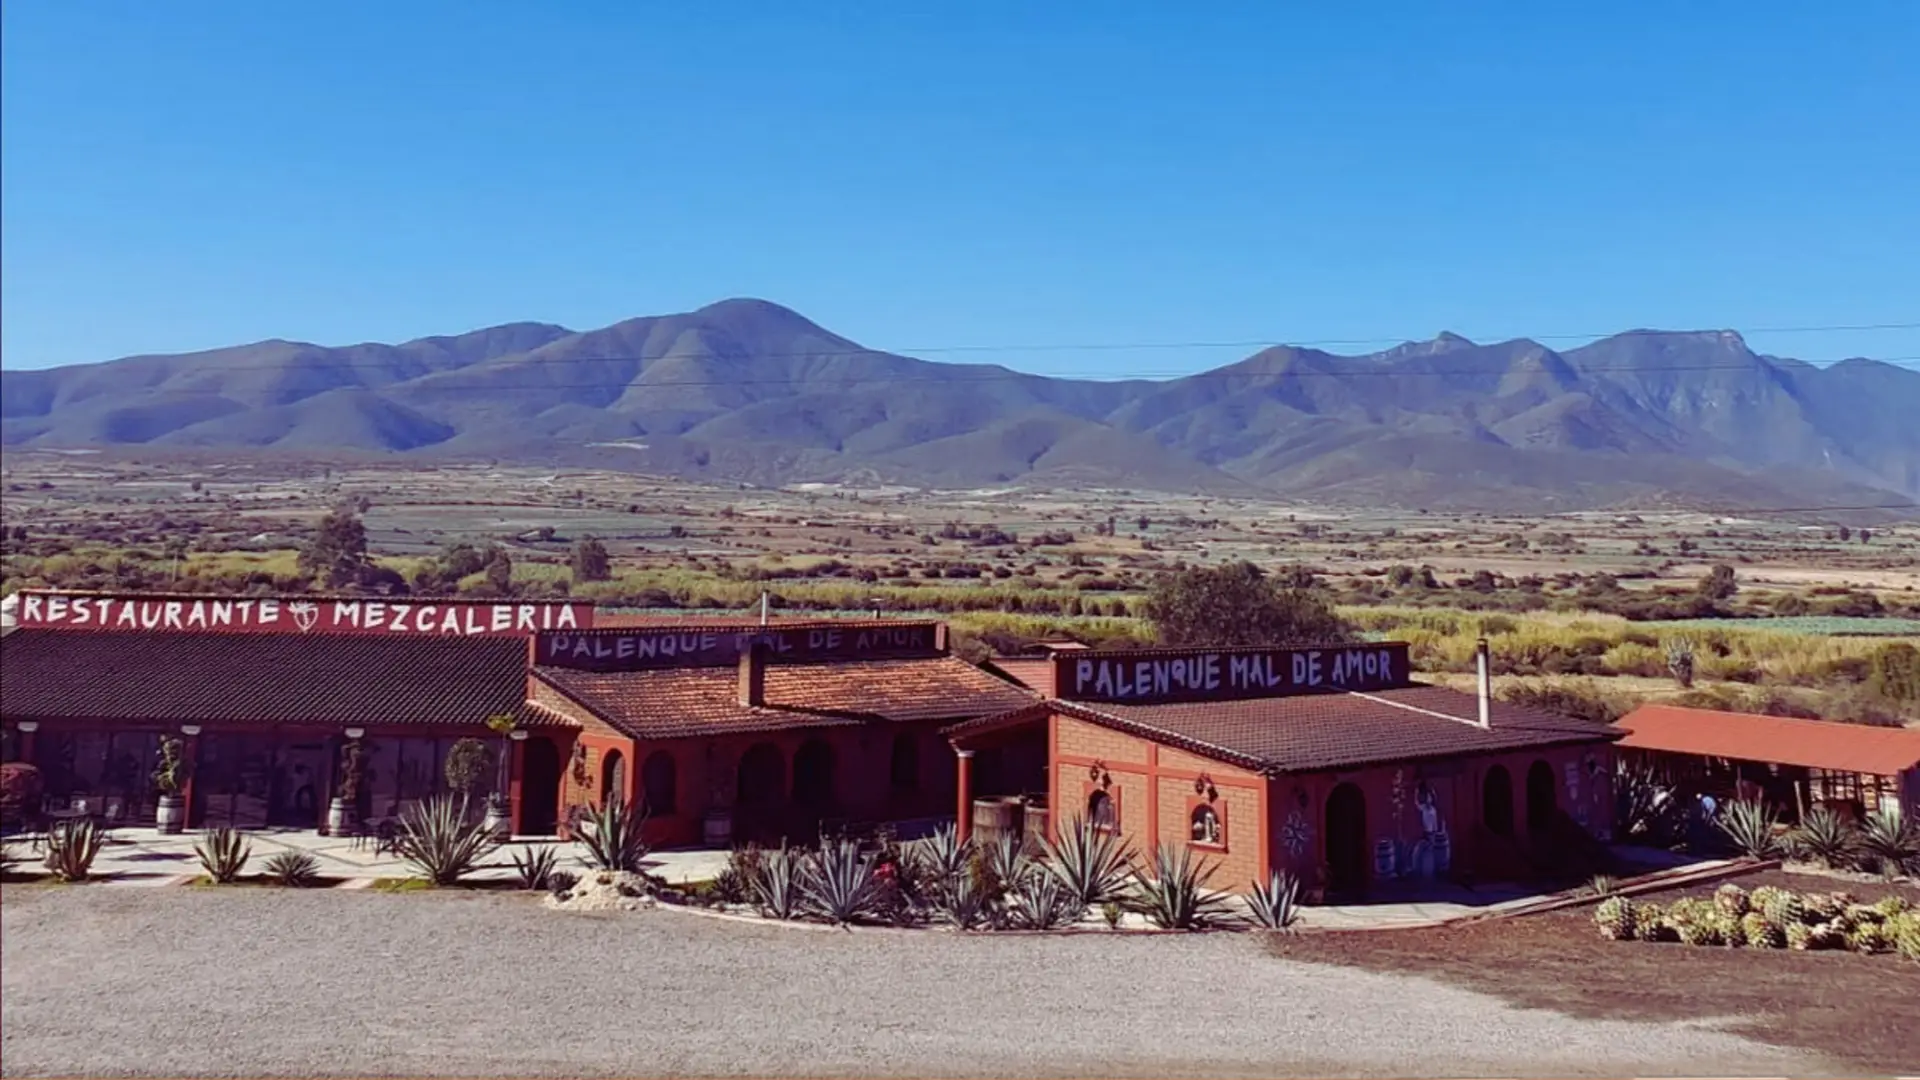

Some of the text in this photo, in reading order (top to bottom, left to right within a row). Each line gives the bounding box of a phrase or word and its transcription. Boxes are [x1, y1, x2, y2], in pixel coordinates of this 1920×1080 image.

[24, 597, 578, 634] RESTAURANTE MEZCALERIA
[550, 632, 717, 658] PALENQUE
[809, 629, 841, 649] DE
[1076, 650, 1393, 697] PALENQUE MAL DE AMOR
